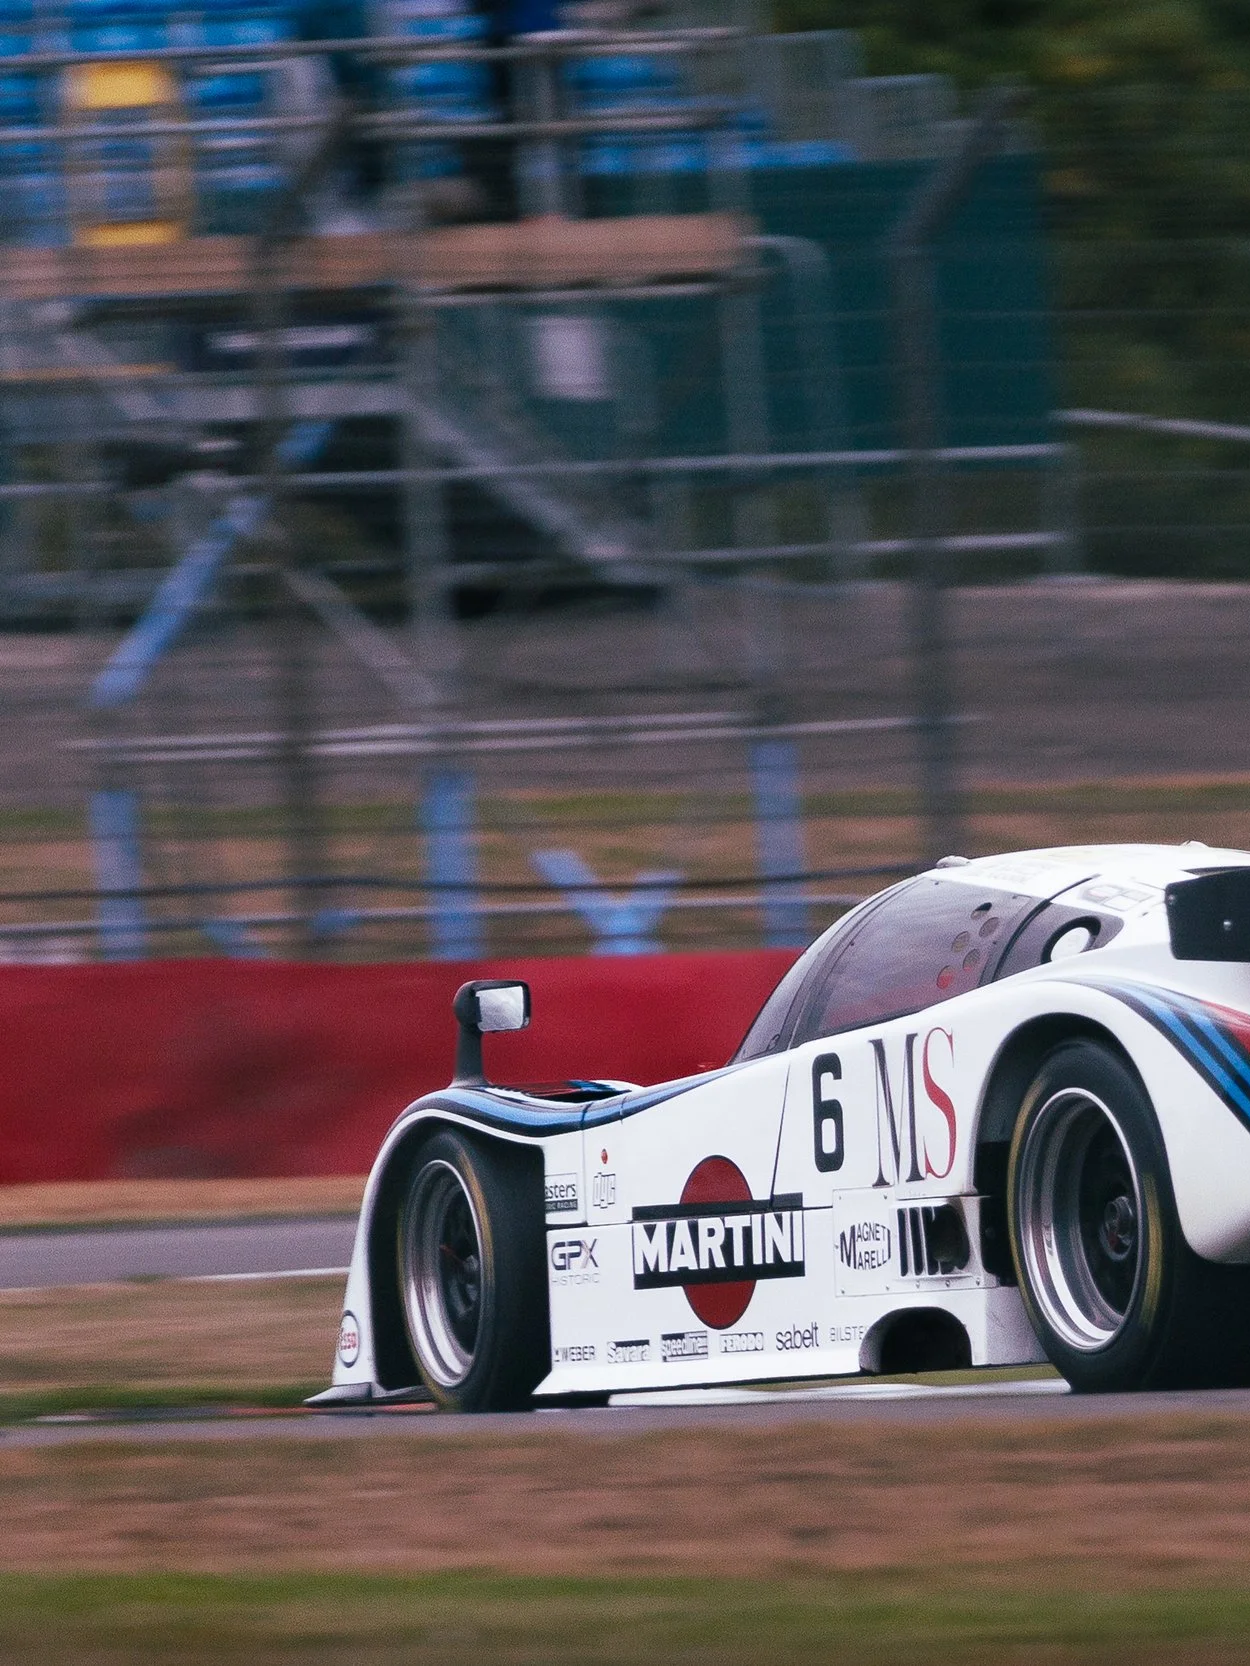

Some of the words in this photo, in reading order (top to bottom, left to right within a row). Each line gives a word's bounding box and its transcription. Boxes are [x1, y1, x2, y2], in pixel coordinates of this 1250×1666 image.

[812, 1052, 845, 1173] 6
[868, 1027, 957, 1188] MS
[551, 1238, 599, 1271] GPX
[632, 1210, 804, 1275] MARTINI
[775, 1322, 820, 1351] sabelt
[829, 1325, 867, 1342] BILSTE
